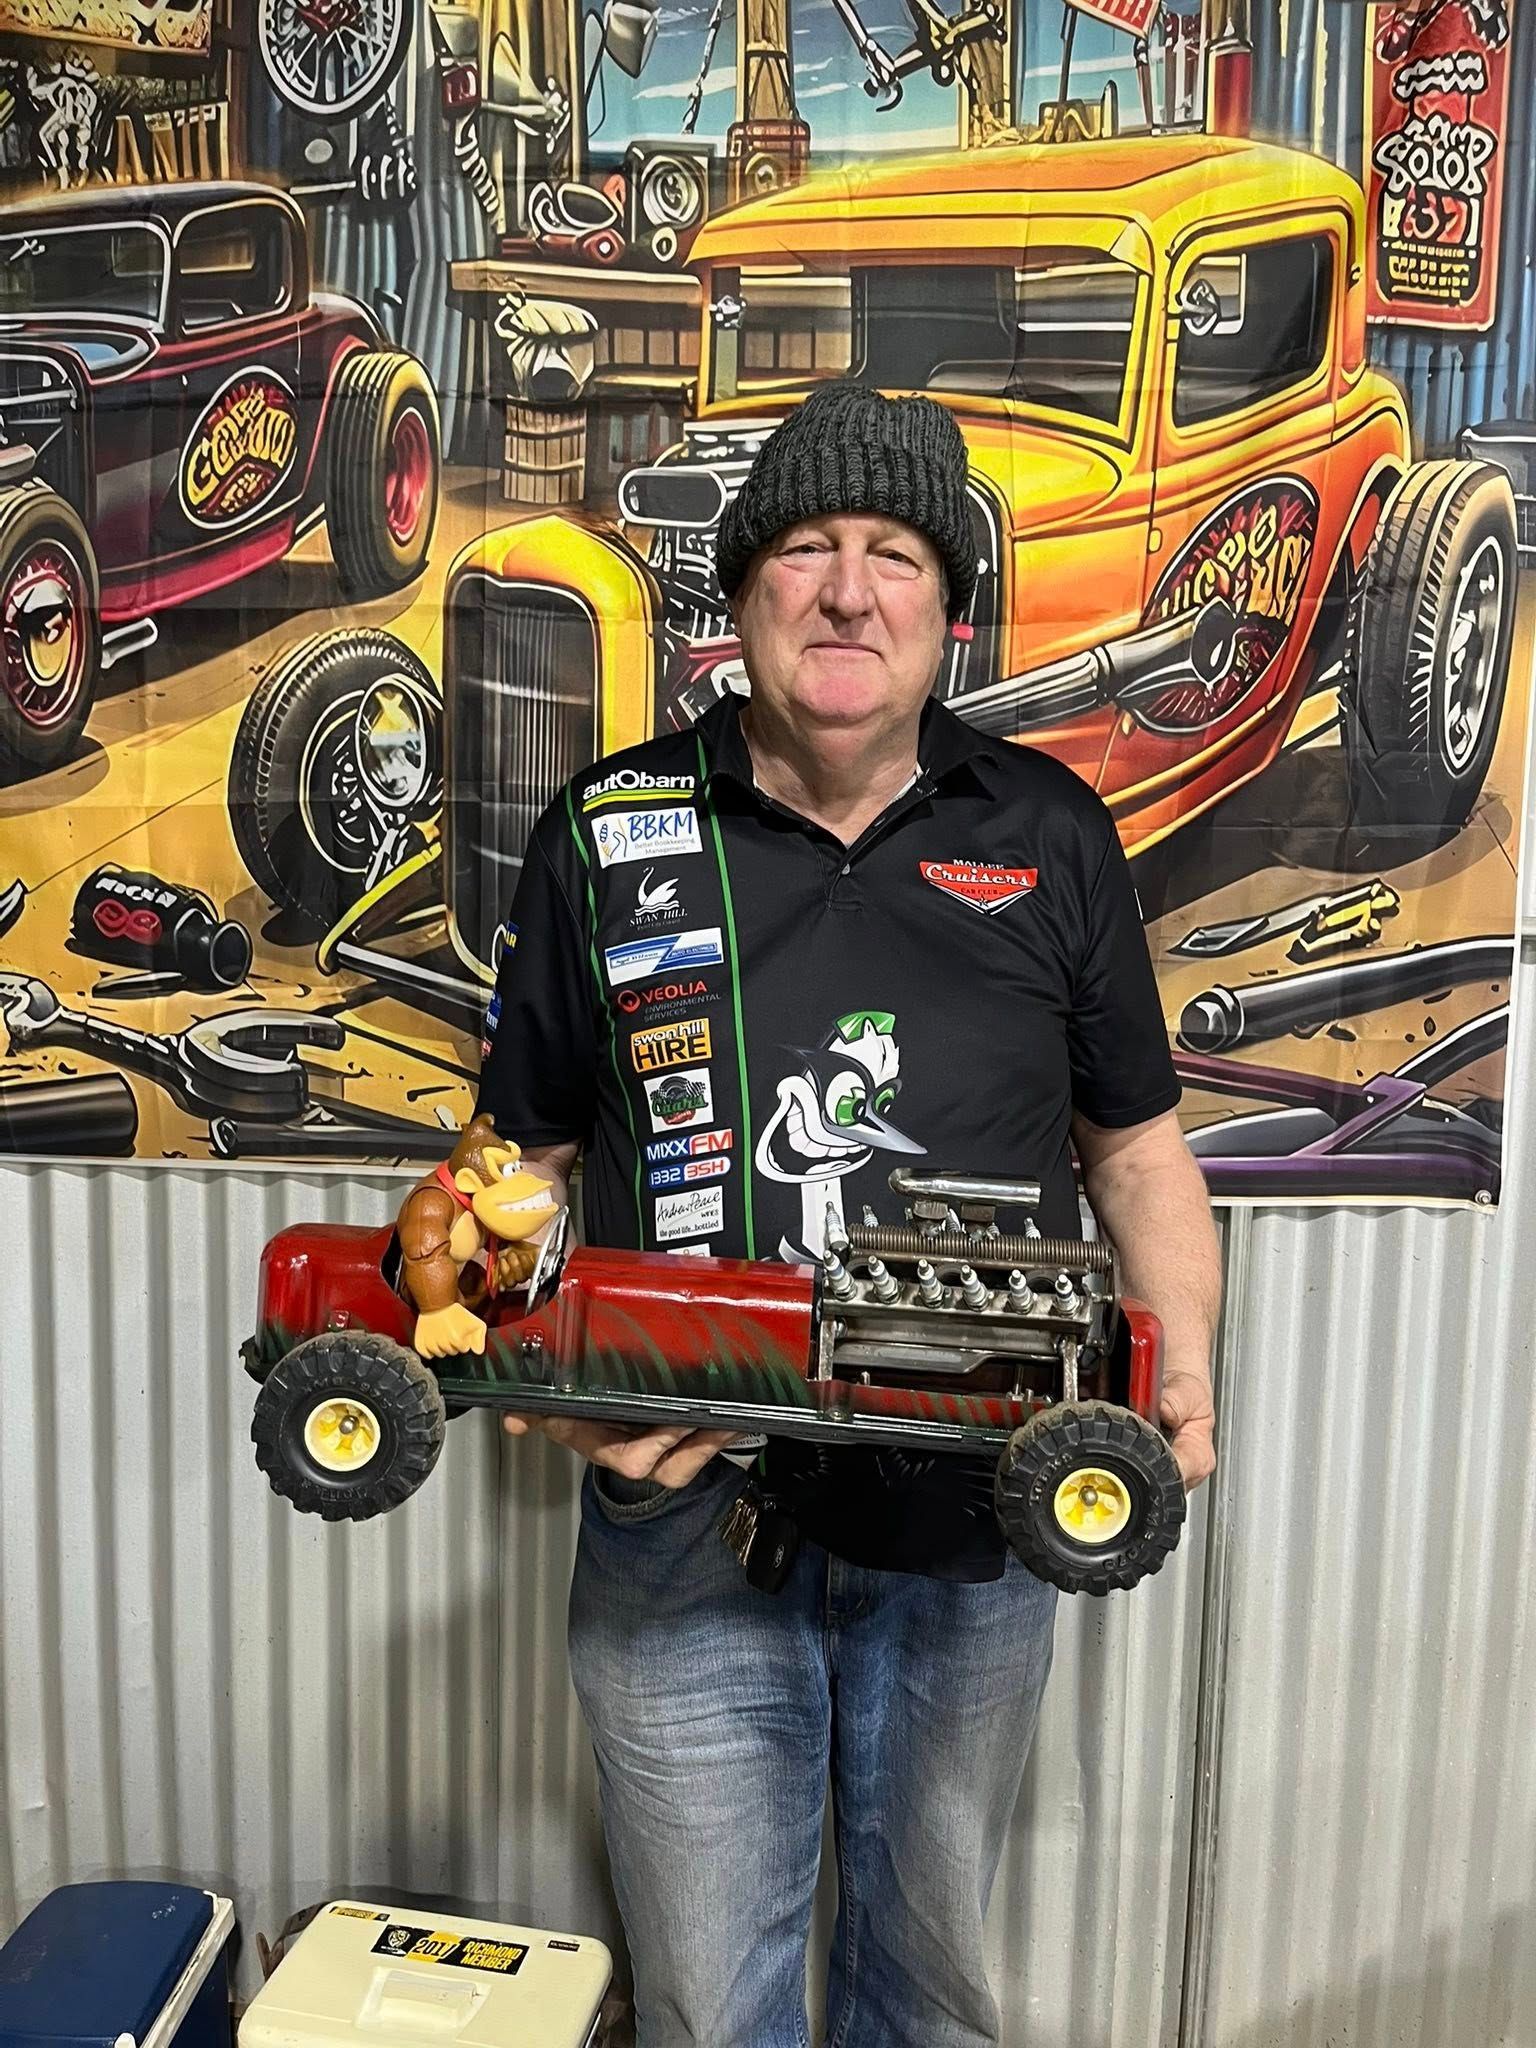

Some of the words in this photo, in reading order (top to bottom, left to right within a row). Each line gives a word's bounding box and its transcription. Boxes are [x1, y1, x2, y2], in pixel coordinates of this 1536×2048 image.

[627, 810, 693, 842] BBKM
[645, 846, 687, 854] Management
[654, 838, 695, 846] Bookkeeping
[925, 864, 1032, 887] Cruisers
[630, 912, 659, 926] SWAN
[641, 980, 708, 1004] VEOLIA
[644, 1006, 687, 1023] SERVICES
[645, 993, 722, 1014] ENVIRONMENTAL
[634, 1028, 677, 1047] swan
[678, 1020, 705, 1038] hill
[635, 1034, 707, 1070] HIRE
[647, 1138, 689, 1161] MIXX
[691, 1131, 732, 1155] FM
[650, 1168, 681, 1185] 1332
[687, 1160, 725, 1176] 3SH
[669, 1227, 681, 1238] good
[411, 1938, 459, 1958] 2017
[463, 1941, 523, 1960] RICHMOND
[460, 1954, 513, 1970] MEMBER
